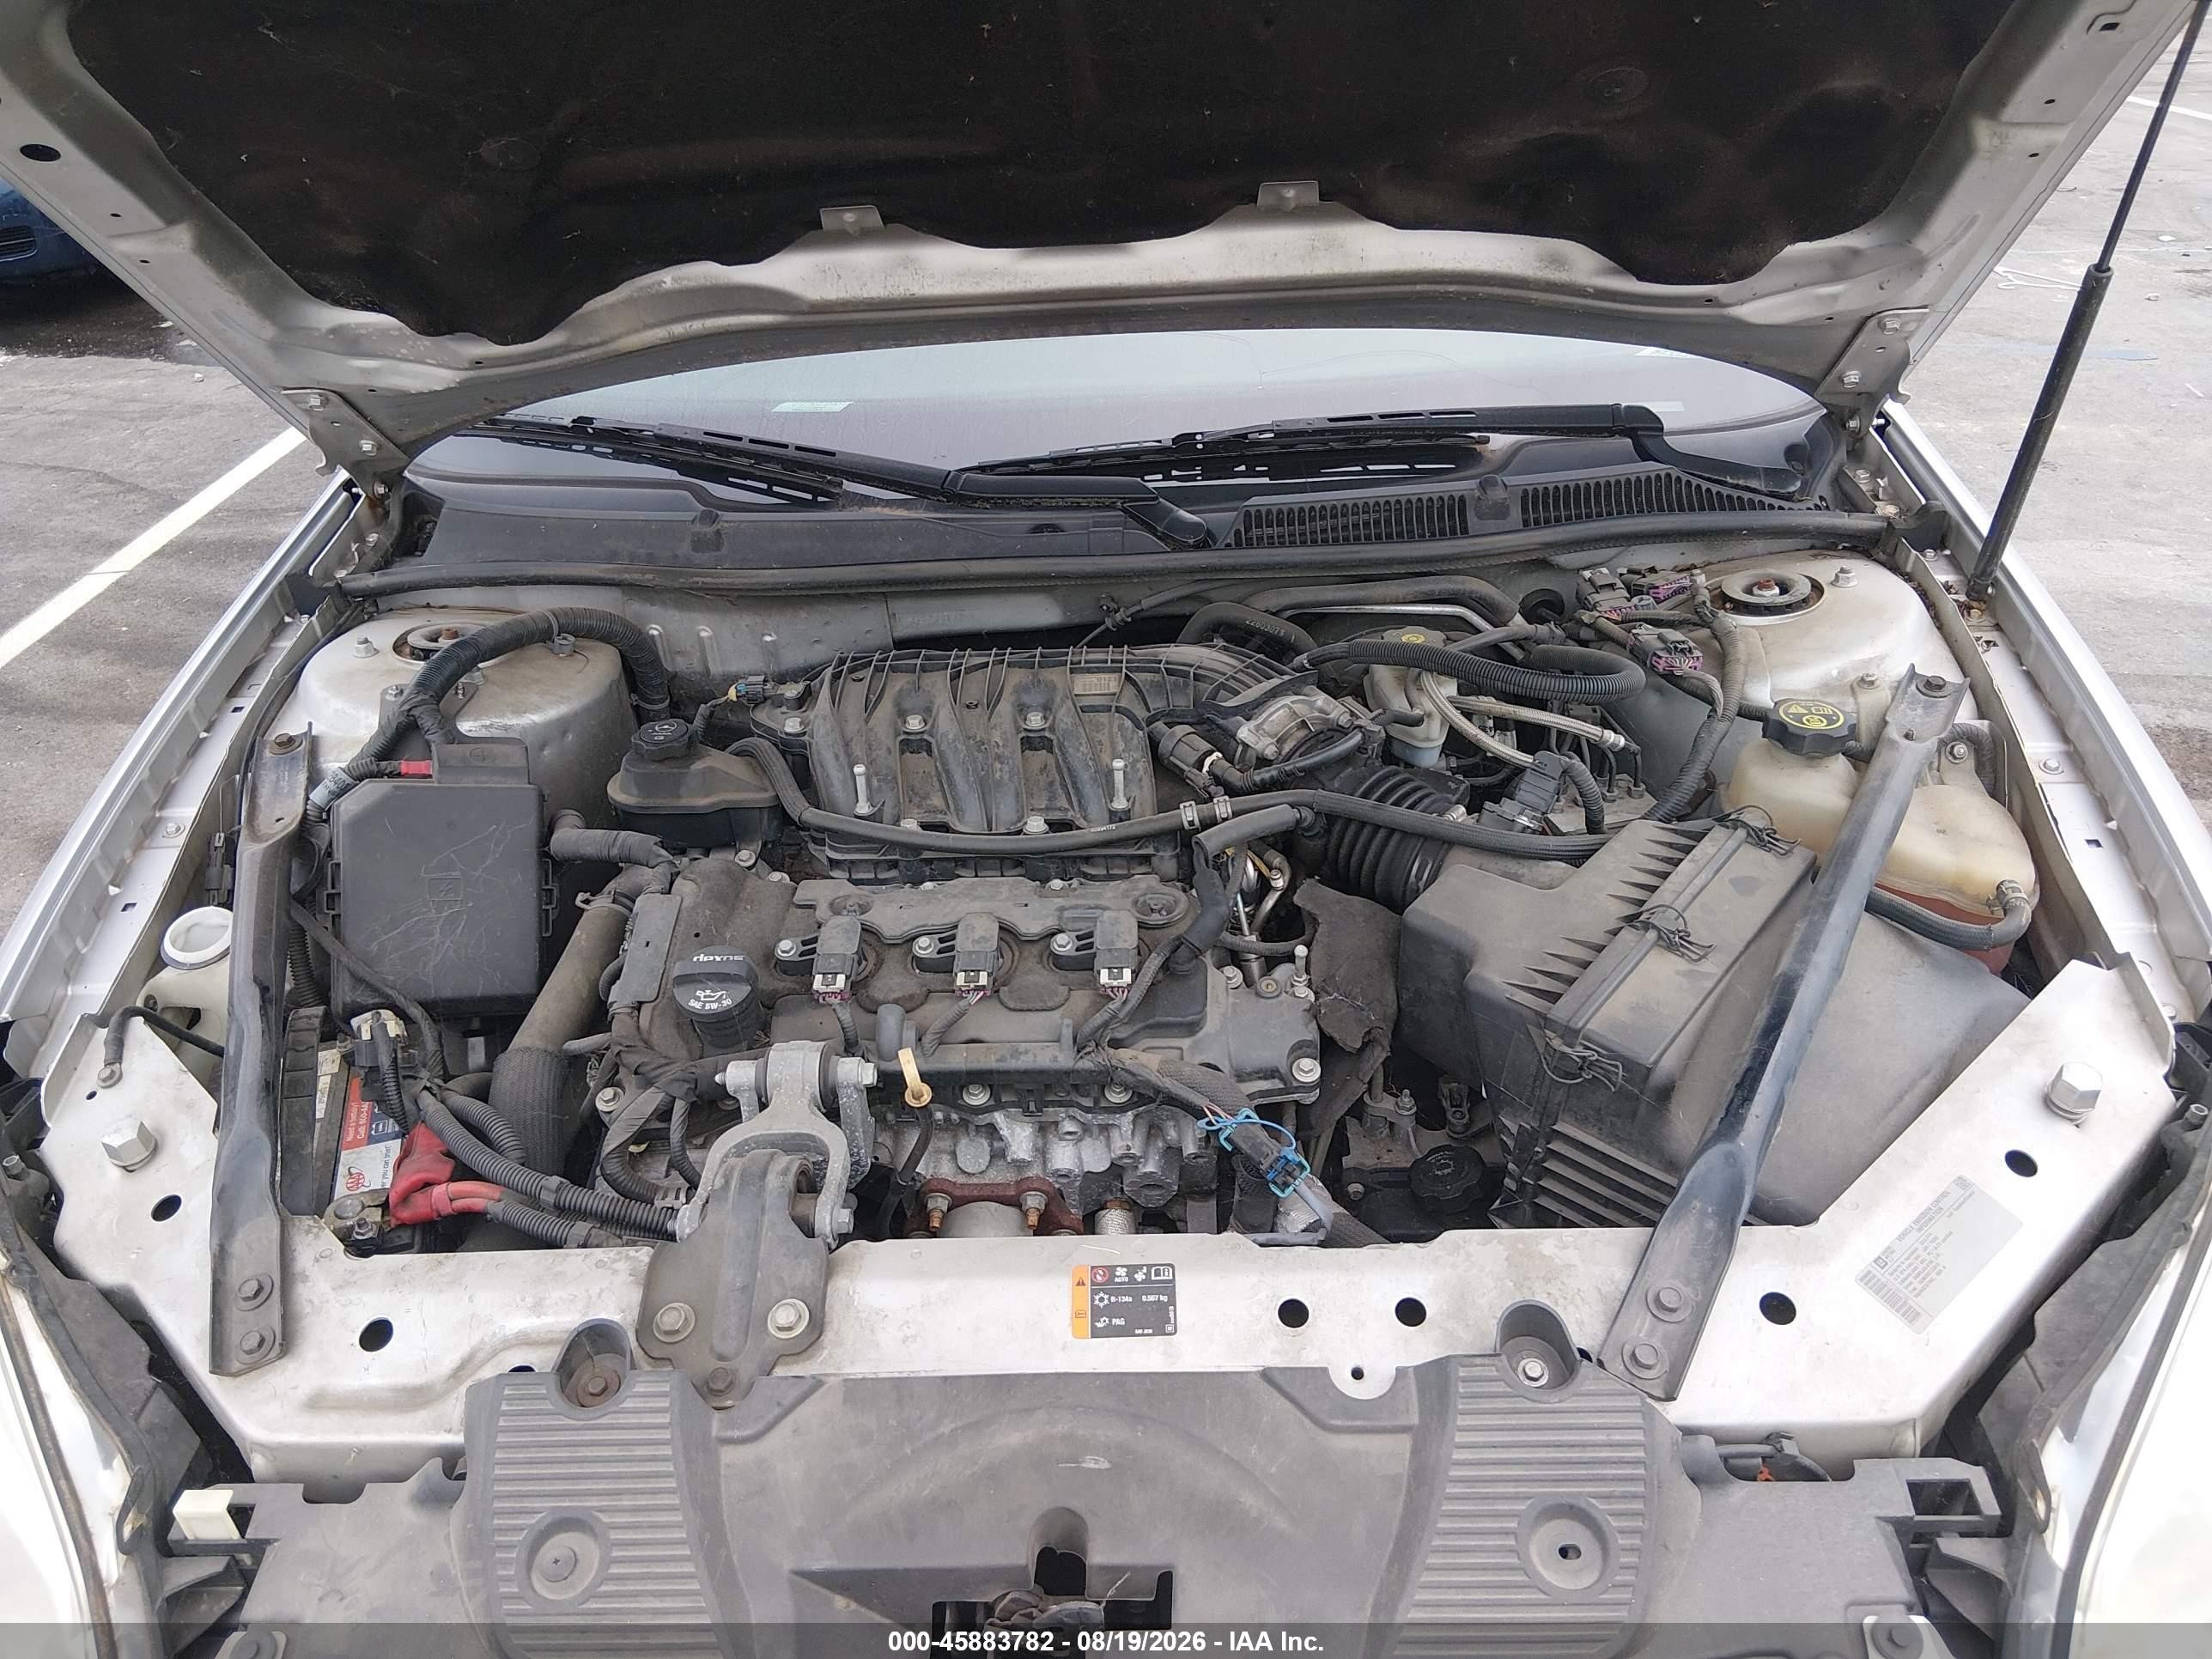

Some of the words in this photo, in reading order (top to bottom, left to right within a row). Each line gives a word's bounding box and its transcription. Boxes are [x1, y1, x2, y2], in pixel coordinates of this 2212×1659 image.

[688, 999, 704, 1009] SAE
[705, 998, 732, 1010] 5W-30
[1112, 1317, 1125, 1326] PAG
